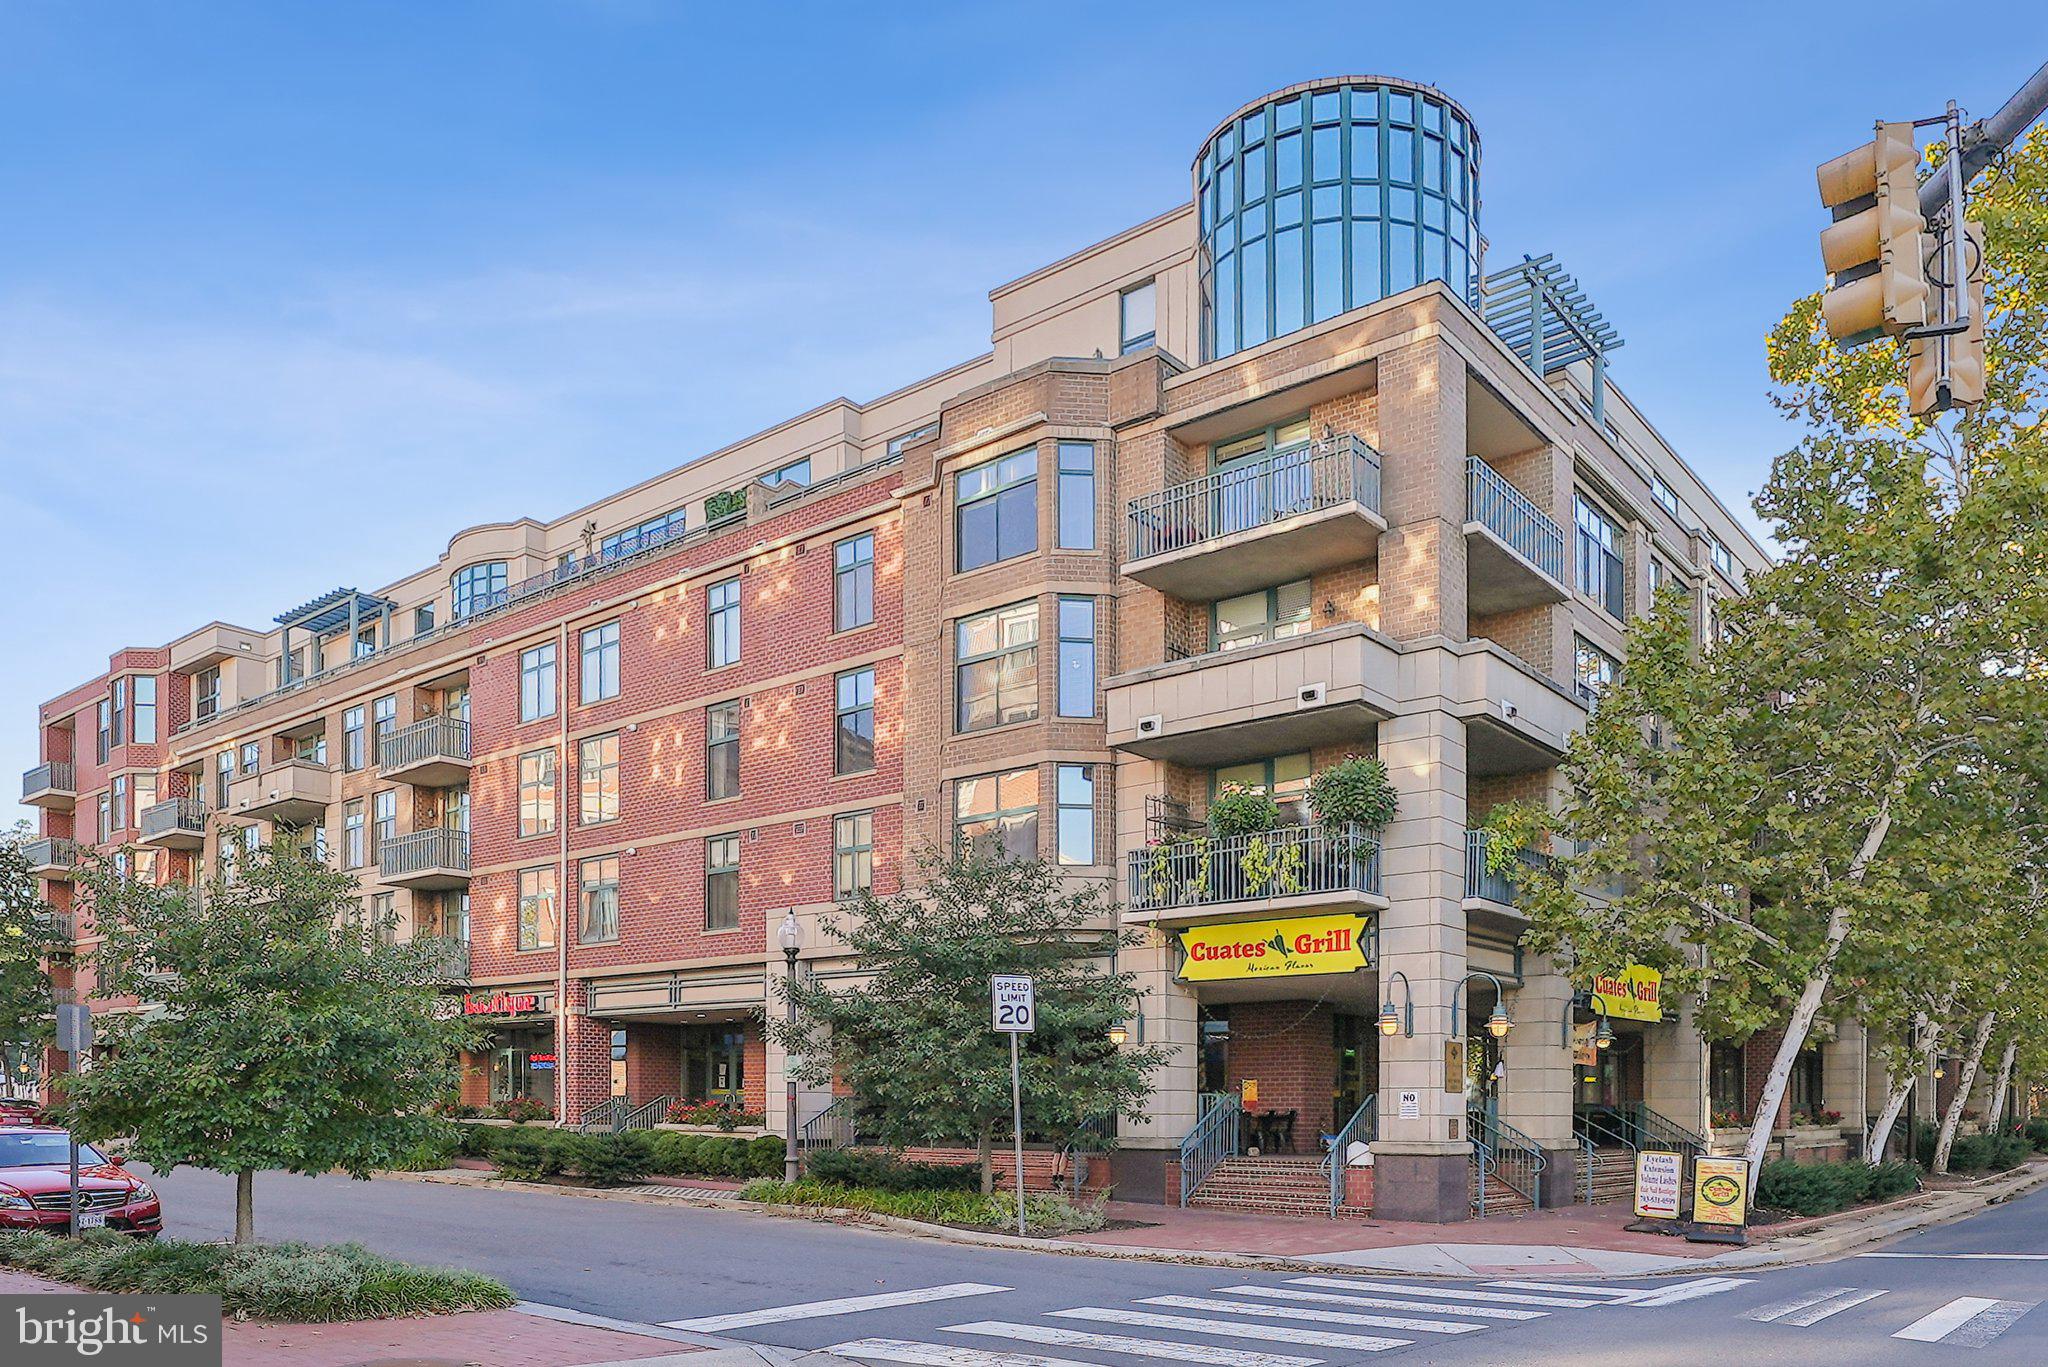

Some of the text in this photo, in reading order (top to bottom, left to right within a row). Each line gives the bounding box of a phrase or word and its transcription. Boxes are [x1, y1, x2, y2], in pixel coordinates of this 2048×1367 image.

[1190, 929, 1352, 962] Cuates Grill
[996, 982, 1029, 991] SPEED
[1595, 974, 1657, 1002] Cuates Grill
[1001, 993, 1026, 1002] LIMIT
[999, 1004, 1029, 1025] 20
[1403, 1093, 1416, 1102] NO
[1646, 1154, 1674, 1164] Eyelash
[1644, 1164, 1675, 1174] Extension
[1659, 1175, 1677, 1185] Lashes
